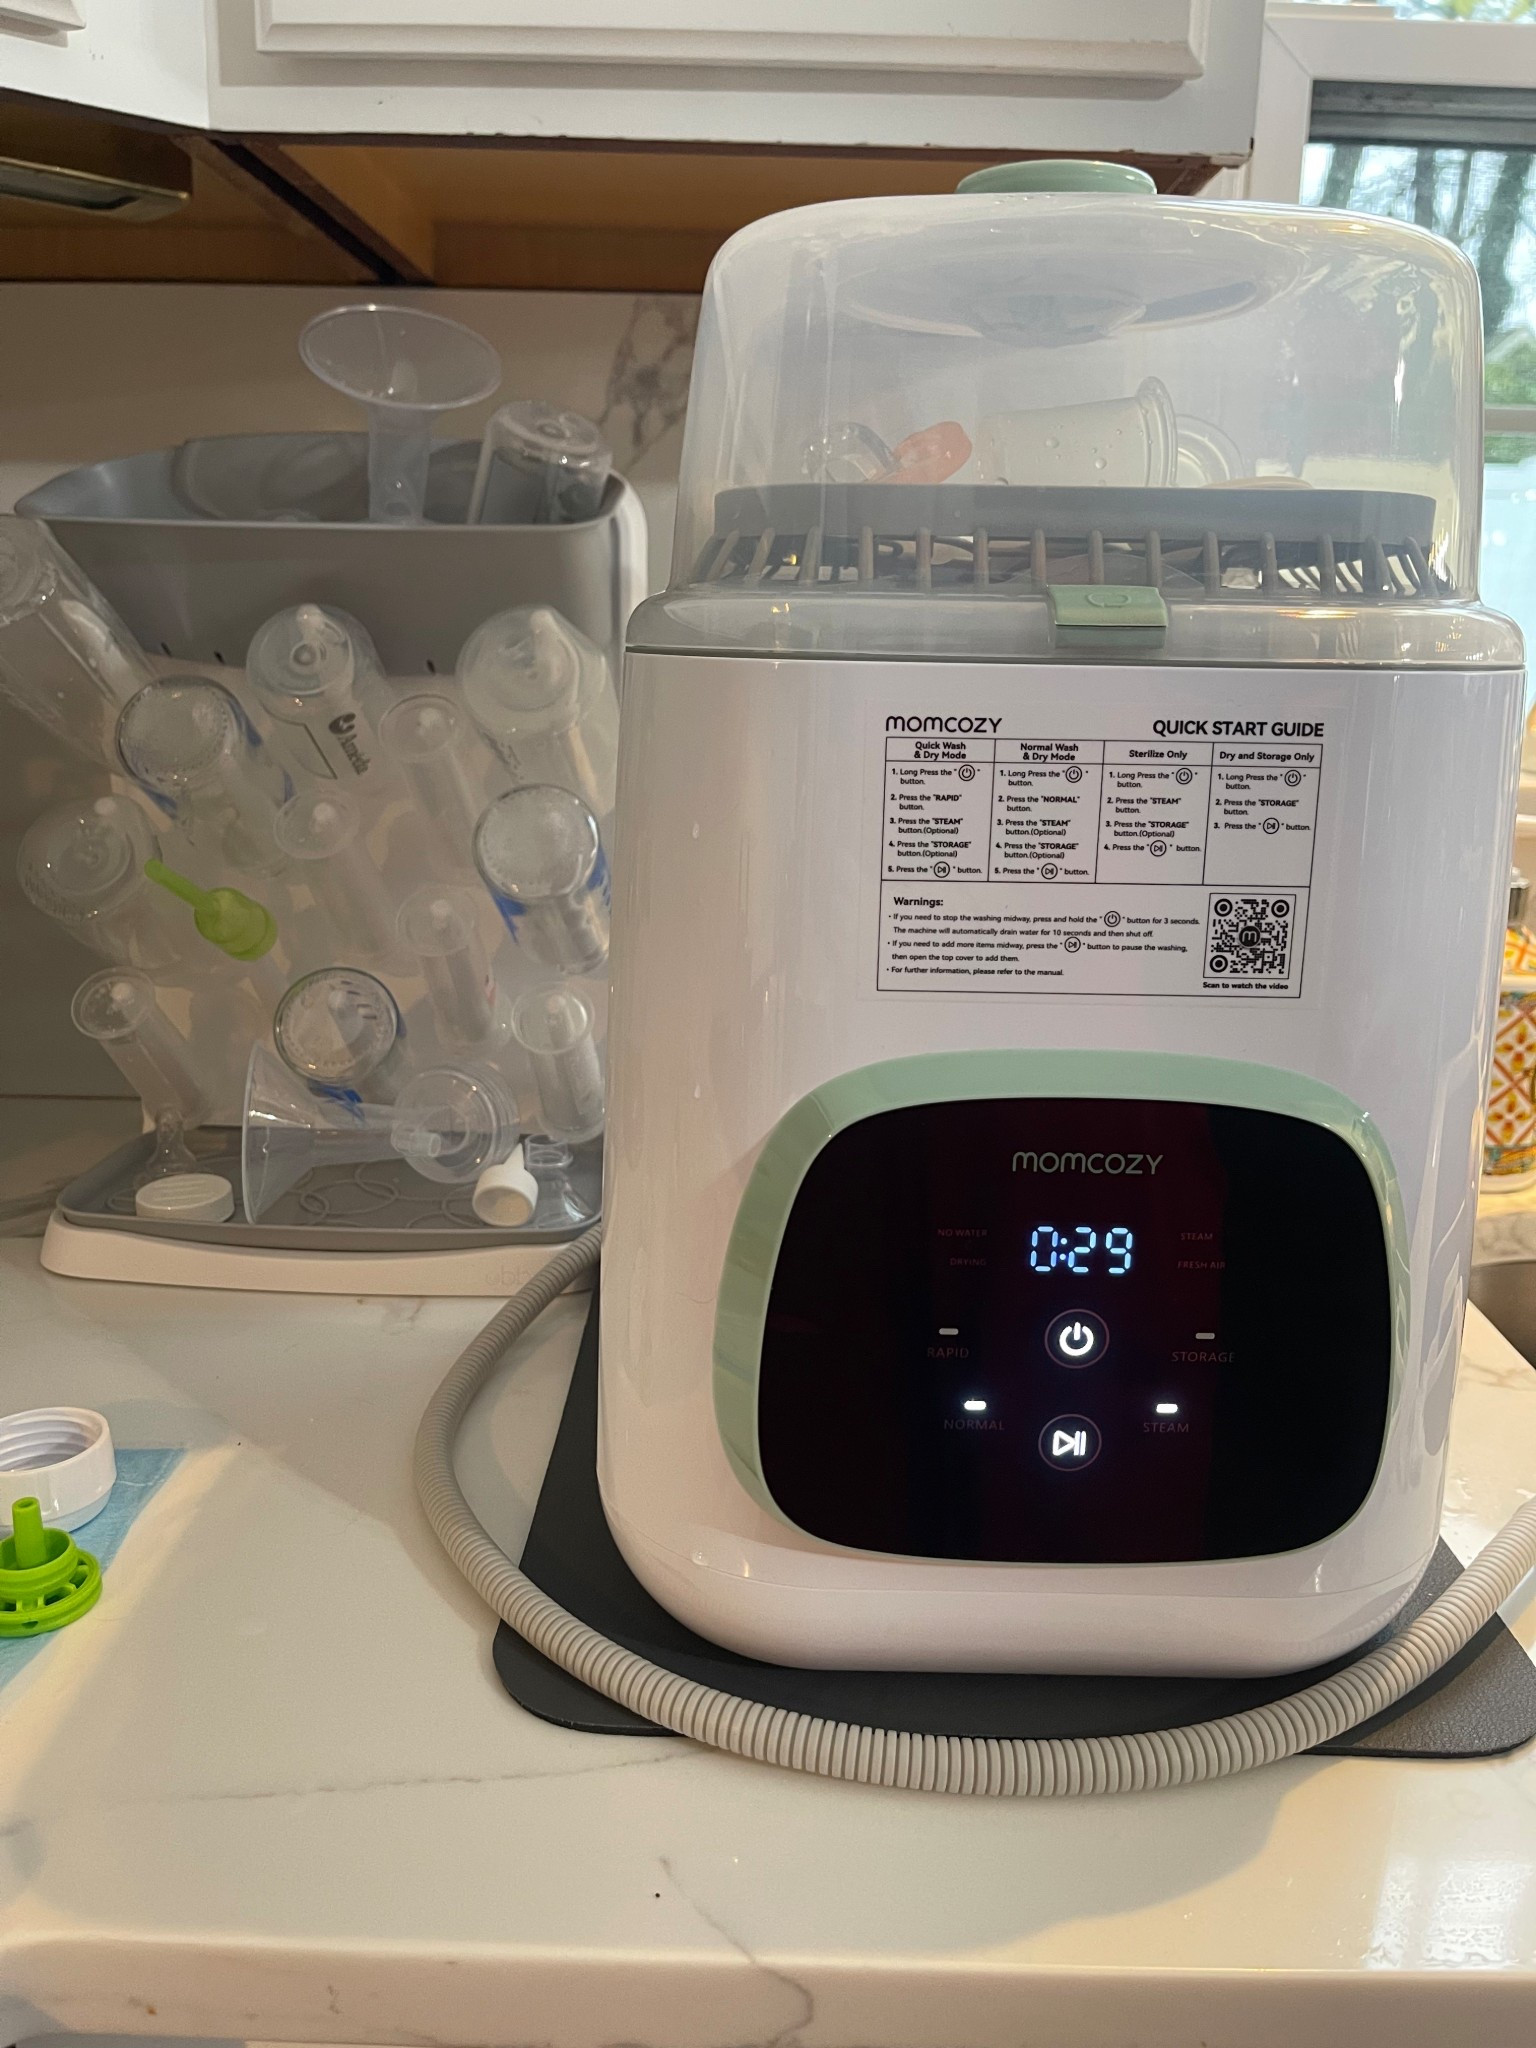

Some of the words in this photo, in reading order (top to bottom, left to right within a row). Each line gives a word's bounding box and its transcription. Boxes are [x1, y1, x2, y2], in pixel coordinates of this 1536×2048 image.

[1152, 720, 1209, 737] QUICK
[1211, 721, 1268, 736] START
[1270, 722, 1324, 736] GUIDE
[914, 741, 941, 749] Quick
[942, 741, 966, 749] Wash
[1020, 742, 1053, 751] Normal
[1054, 743, 1079, 751] Wash
[913, 750, 922, 758] &
[923, 750, 939, 760] Dry
[941, 750, 966, 759] Mode
[1022, 751, 1030, 760] &
[1031, 752, 1049, 762] Dry
[1050, 752, 1075, 760] Mode
[1128, 749, 1165, 757] Sterilize
[1166, 750, 1187, 760] Only
[1219, 751, 1236, 761] Dry
[1237, 751, 1255, 759] and
[1256, 751, 1292, 762] Storage
[1293, 752, 1315, 762] Only
[899, 768, 918, 776] Long
[1007, 770, 1026, 778] Long
[1116, 771, 1136, 780] Long
[1225, 773, 1244, 782] Long
[898, 793, 918, 801] Press
[1115, 796, 1135, 804] Press
[1223, 798, 1243, 806] Press
[1005, 818, 1024, 826] Press
[942, 914, 958, 922] stop
[972, 914, 1001, 923] washing
[1032, 916, 1052, 924] press
[1152, 916, 1162, 924] for
[951, 927, 998, 935] automatically
[1062, 929, 1091, 937] seconds
[941, 954, 954, 962] top
[972, 967, 995, 975] please
[955, 1229, 987, 1237] WATER
[1181, 1233, 1213, 1241] STEAM
[1031, 1225, 1133, 1273] 0:29
[950, 1258, 986, 1266] DRYING
[1177, 1261, 1207, 1269] FRESH
[927, 1347, 969, 1358] RAPID
[1172, 1351, 1235, 1363] STORAGE
[944, 1420, 1004, 1431] NORMAL
[1144, 1422, 1189, 1433] STEAM
